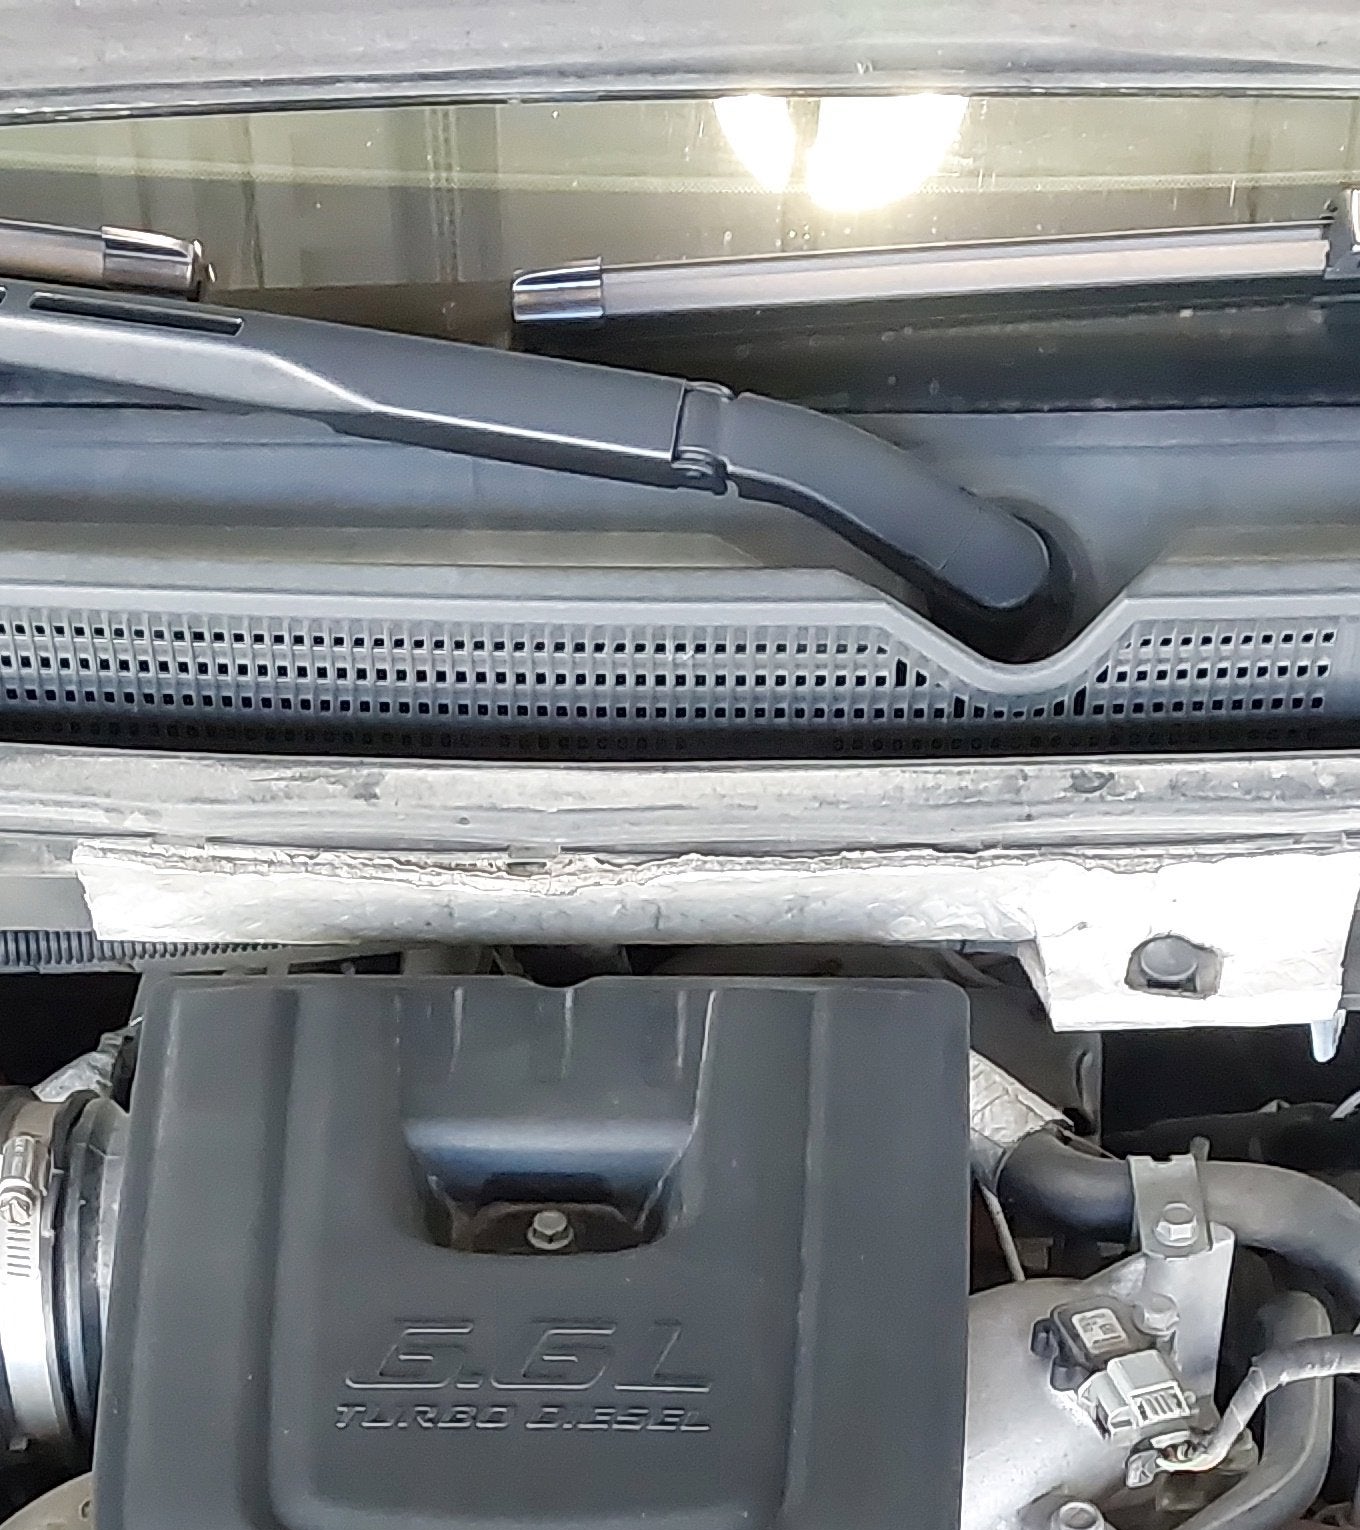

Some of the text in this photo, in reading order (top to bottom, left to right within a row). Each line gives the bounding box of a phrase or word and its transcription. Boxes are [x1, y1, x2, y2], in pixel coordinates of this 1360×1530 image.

[345, 1317, 712, 1393] 6.6L
[336, 1403, 712, 1432] TURBO DIESEL
